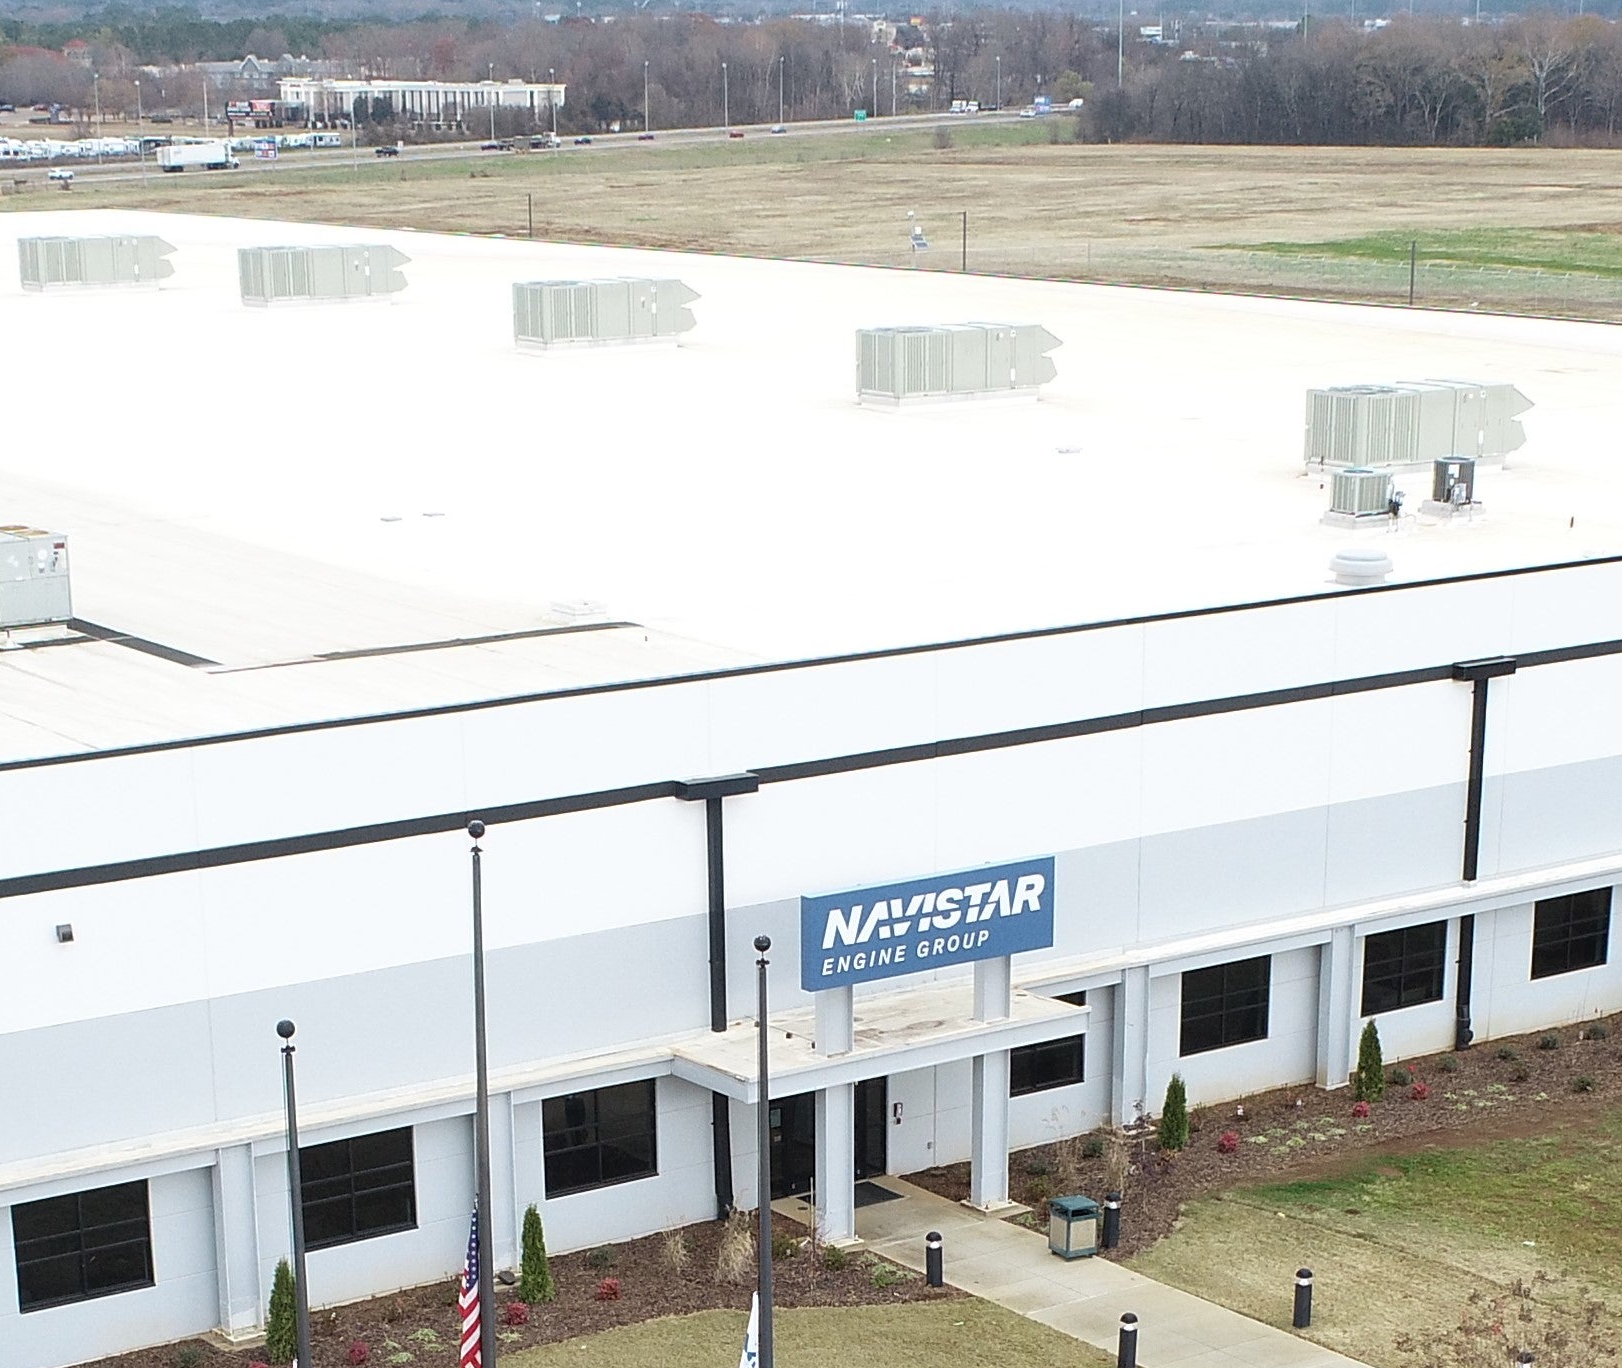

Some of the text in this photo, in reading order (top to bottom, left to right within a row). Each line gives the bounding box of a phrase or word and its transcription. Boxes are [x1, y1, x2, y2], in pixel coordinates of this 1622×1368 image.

[822, 873, 1045, 950] NAVISTAR
[822, 930, 990, 976] ENGINE GROUP
